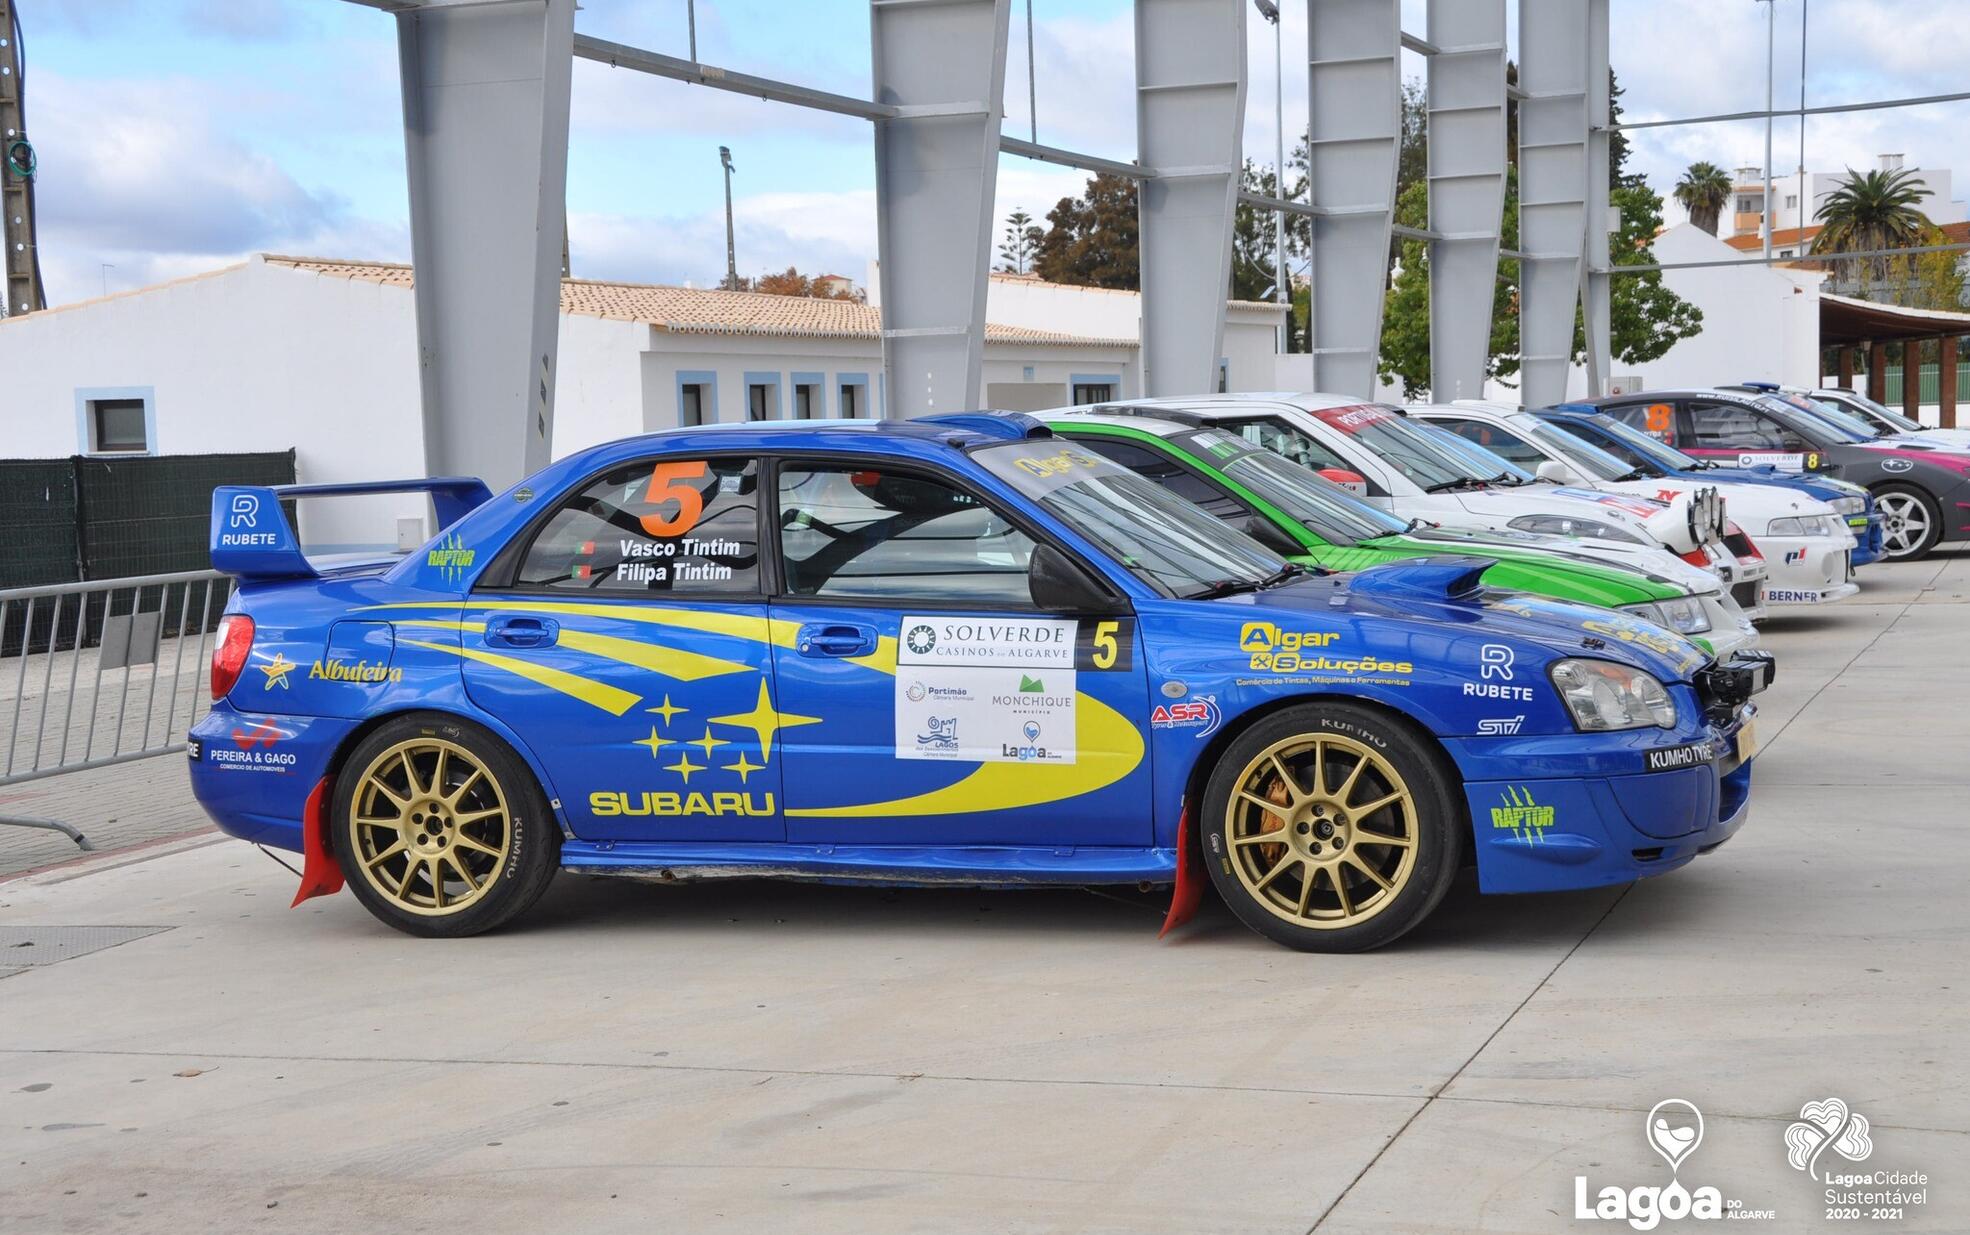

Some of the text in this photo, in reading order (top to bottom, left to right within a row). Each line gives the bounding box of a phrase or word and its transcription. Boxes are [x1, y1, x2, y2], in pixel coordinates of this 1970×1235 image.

[1646, 404, 1671, 431] 8
[1808, 453, 1818, 469] 8
[639, 461, 707, 537] 5
[222, 533, 276, 546] RUBETE
[620, 538, 740, 557] Vasco Tintim
[427, 550, 476, 567] RAPTOR
[617, 562, 732, 585] Filipa Tintim
[1769, 591, 1817, 602] BERNER
[944, 625, 1064, 643] SOLVERDE
[1240, 622, 1340, 652] Algar
[936, 646, 994, 657] CASINOS
[1008, 648, 1068, 659] ALGARVE
[1092, 621, 1120, 670] 5
[1272, 652, 1413, 674] Soluções
[308, 660, 402, 686] Albufeira
[1357, 677, 1410, 687] Ferramentas
[928, 687, 967, 696] Portimão
[1463, 683, 1533, 701] RUBETE
[992, 696, 1071, 707] MONCHIQUE
[1151, 703, 1210, 723] ASR
[1321, 718, 1387, 749] KUMHO
[210, 749, 296, 765] PEREIRA & GAGO
[1003, 743, 1047, 761] Lagoa
[1650, 744, 1713, 769] KUMHO TYRE
[590, 792, 775, 816] SUBARU
[1490, 806, 1554, 828] RAPTOR
